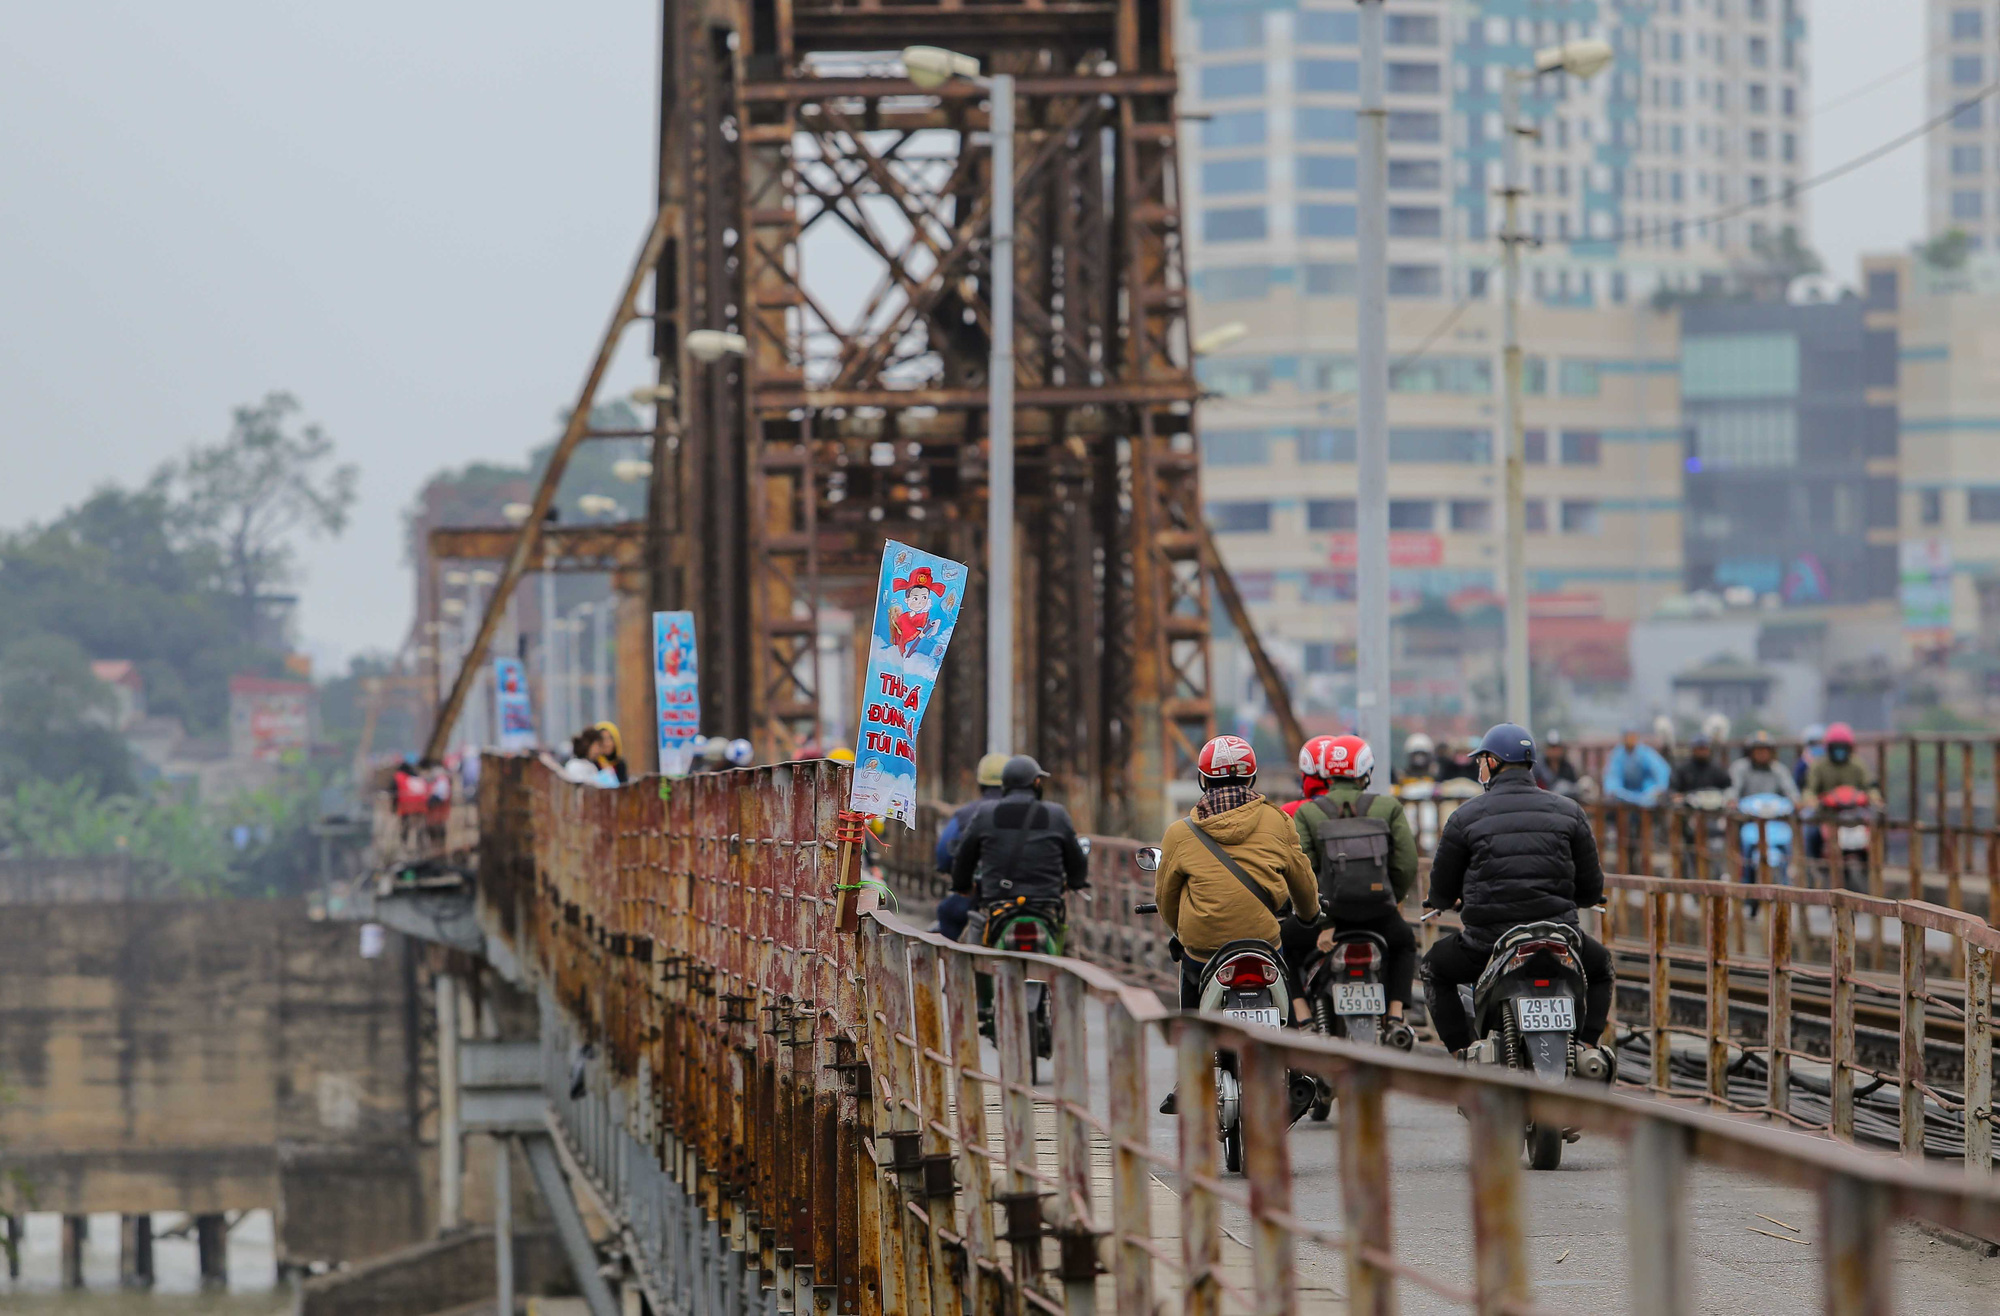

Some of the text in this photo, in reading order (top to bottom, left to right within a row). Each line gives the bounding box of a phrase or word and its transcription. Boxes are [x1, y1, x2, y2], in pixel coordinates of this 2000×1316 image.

[866, 731, 893, 754] TÚI
[1342, 985, 1376, 998] 37-L1
[1339, 999, 1382, 1011] 459.09
[1526, 1000, 1566, 1014] 29-K1
[1523, 1014, 1572, 1029] 559.05
